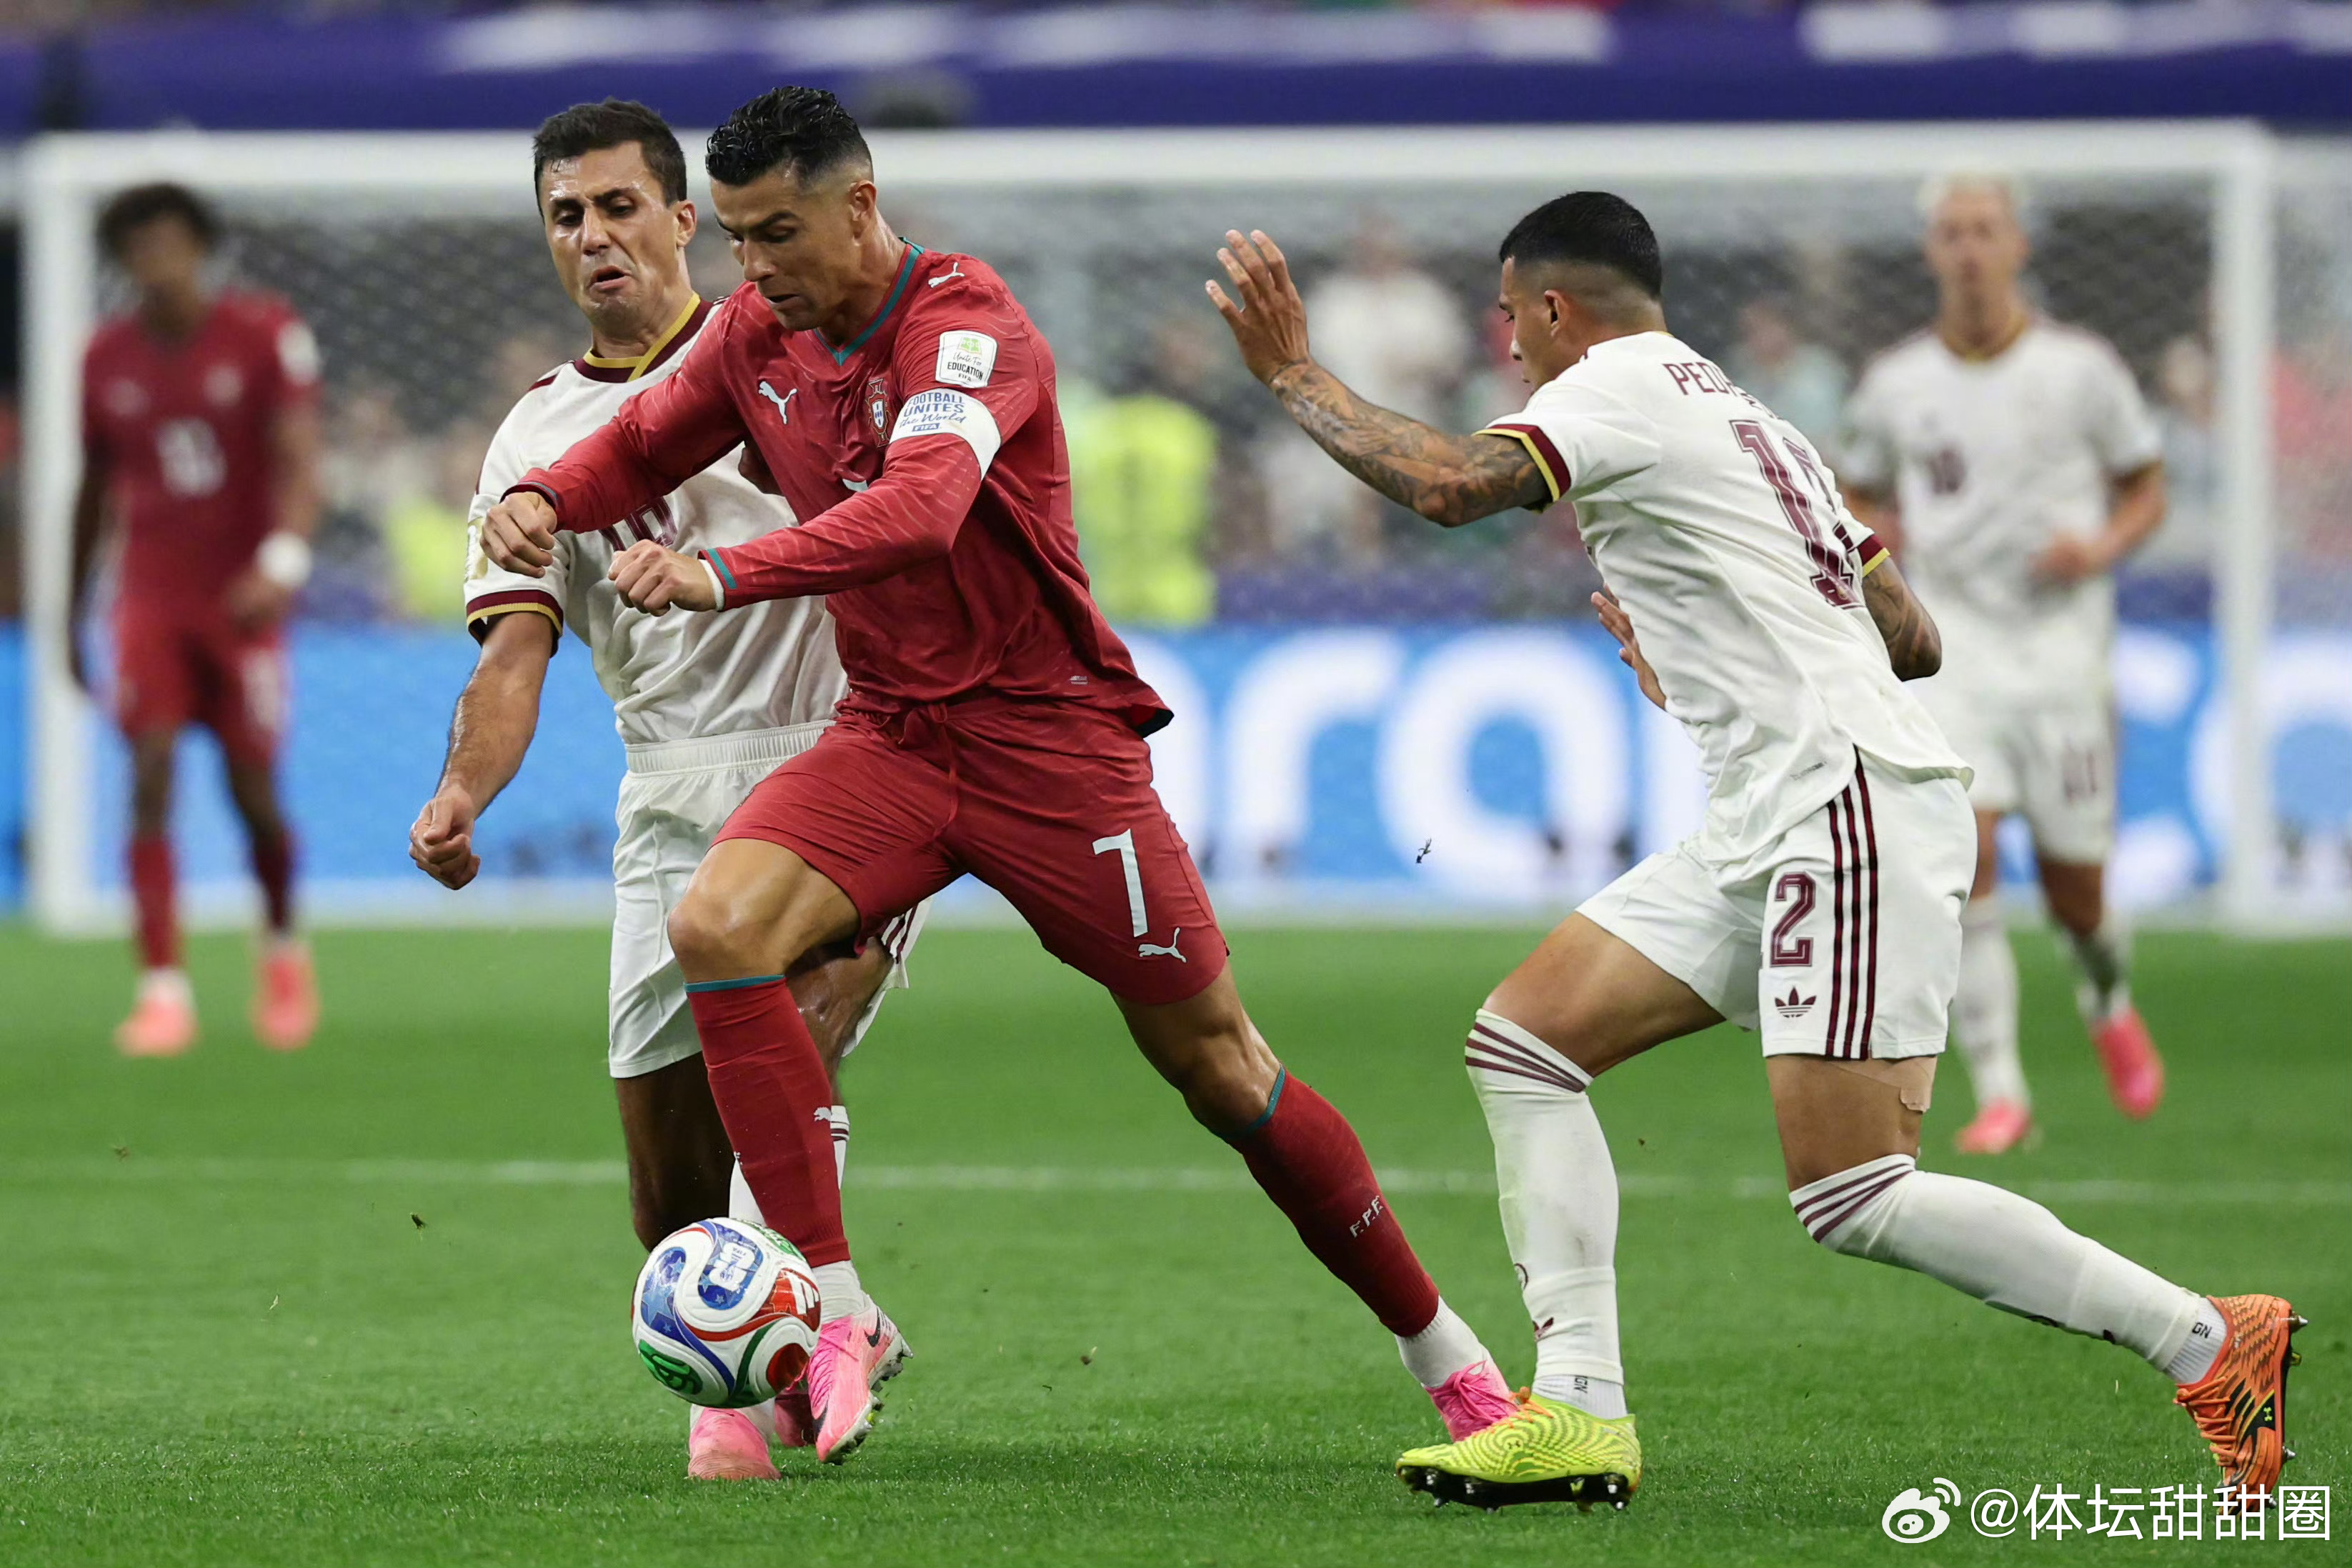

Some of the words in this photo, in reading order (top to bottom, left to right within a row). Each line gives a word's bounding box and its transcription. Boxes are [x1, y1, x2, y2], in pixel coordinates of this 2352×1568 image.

[947, 361, 984, 380] EDUCATION
[958, 373, 972, 381] FIFA
[907, 392, 965, 407] FOOTBALL
[904, 403, 965, 417] UNITES
[900, 417, 919, 429] the
[921, 412, 967, 424] World
[1092, 829, 1148, 937] 7
[1770, 871, 1816, 968] 2
